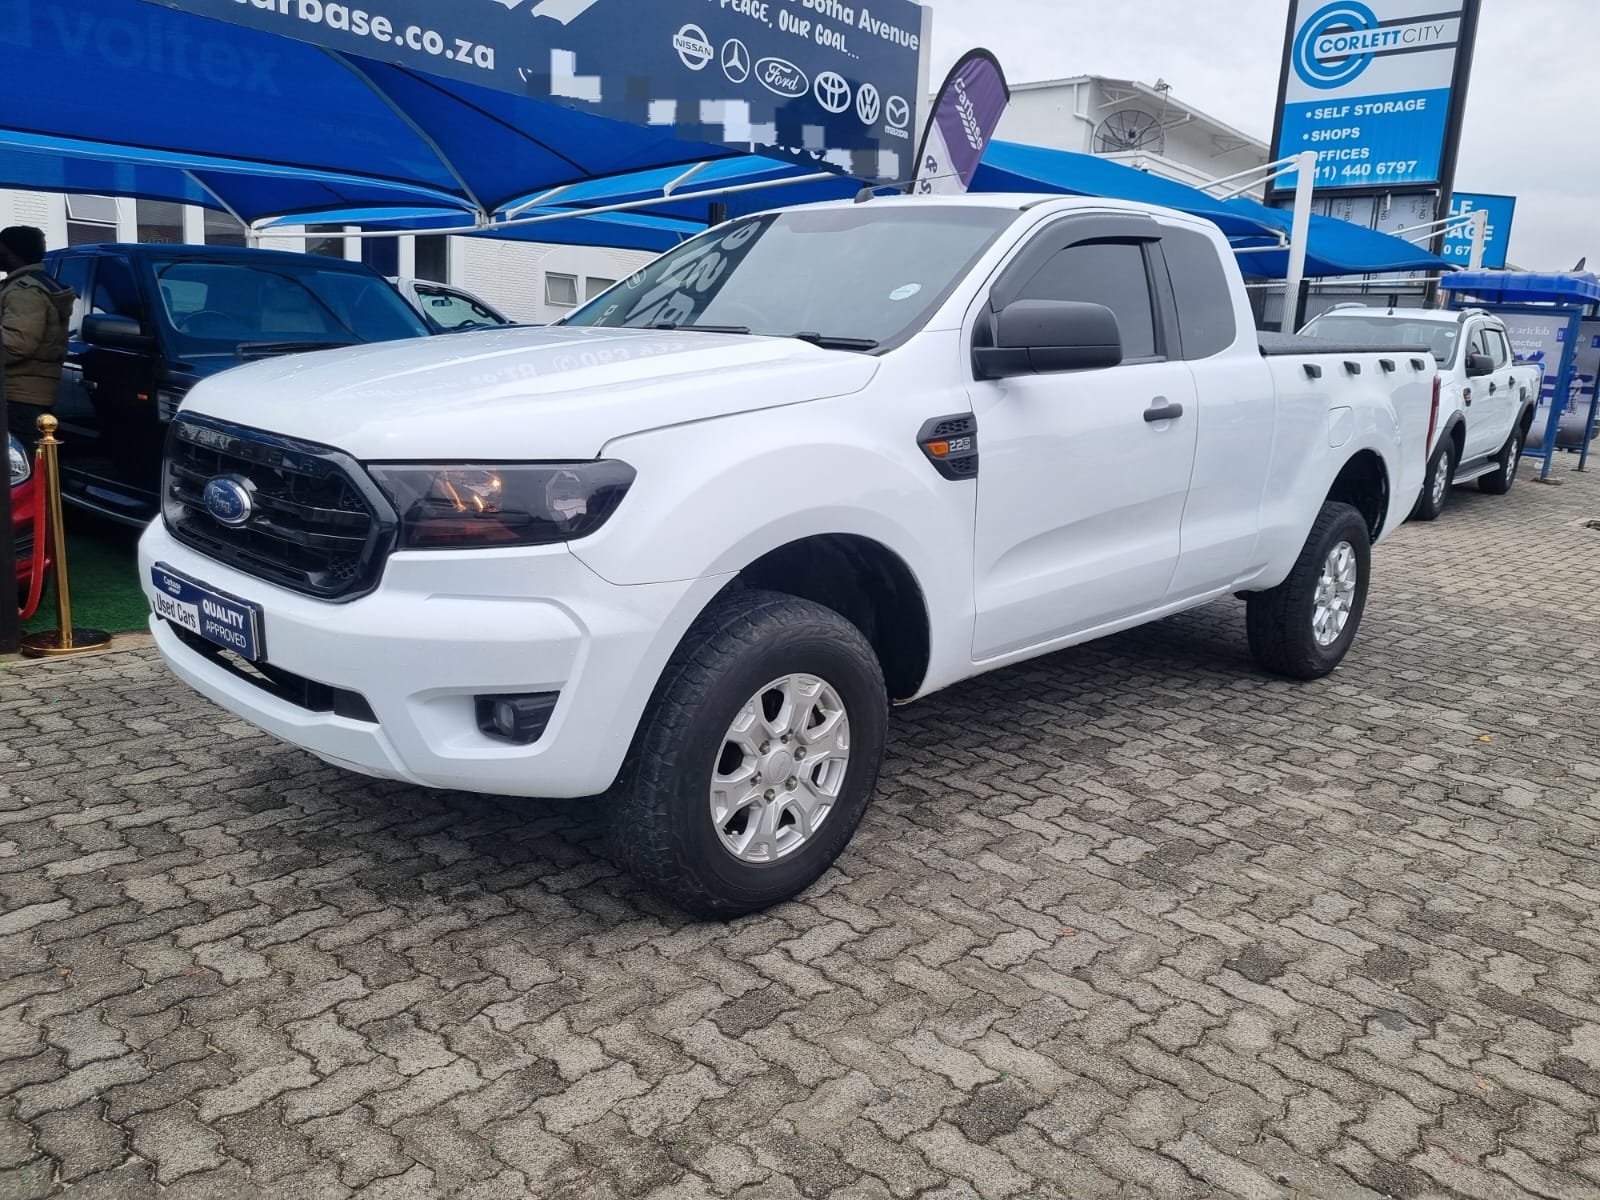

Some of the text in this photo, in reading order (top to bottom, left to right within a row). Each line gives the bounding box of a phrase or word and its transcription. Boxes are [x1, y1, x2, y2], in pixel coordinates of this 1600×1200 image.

[779, 9, 811, 39] OUR
[858, 8, 919, 51] Avenue
[675, 37, 712, 58] NISSAN
[764, 62, 799, 91] Ford
[1314, 98, 1426, 119] SELF STORAGE
[1310, 127, 1360, 142] SHOPS
[1341, 163, 1371, 176] 440
[1376, 160, 1417, 175] 6797
[156, 592, 197, 628] Used Cars
[203, 598, 244, 629] QUALITY
[206, 620, 247, 648] APPROVED
